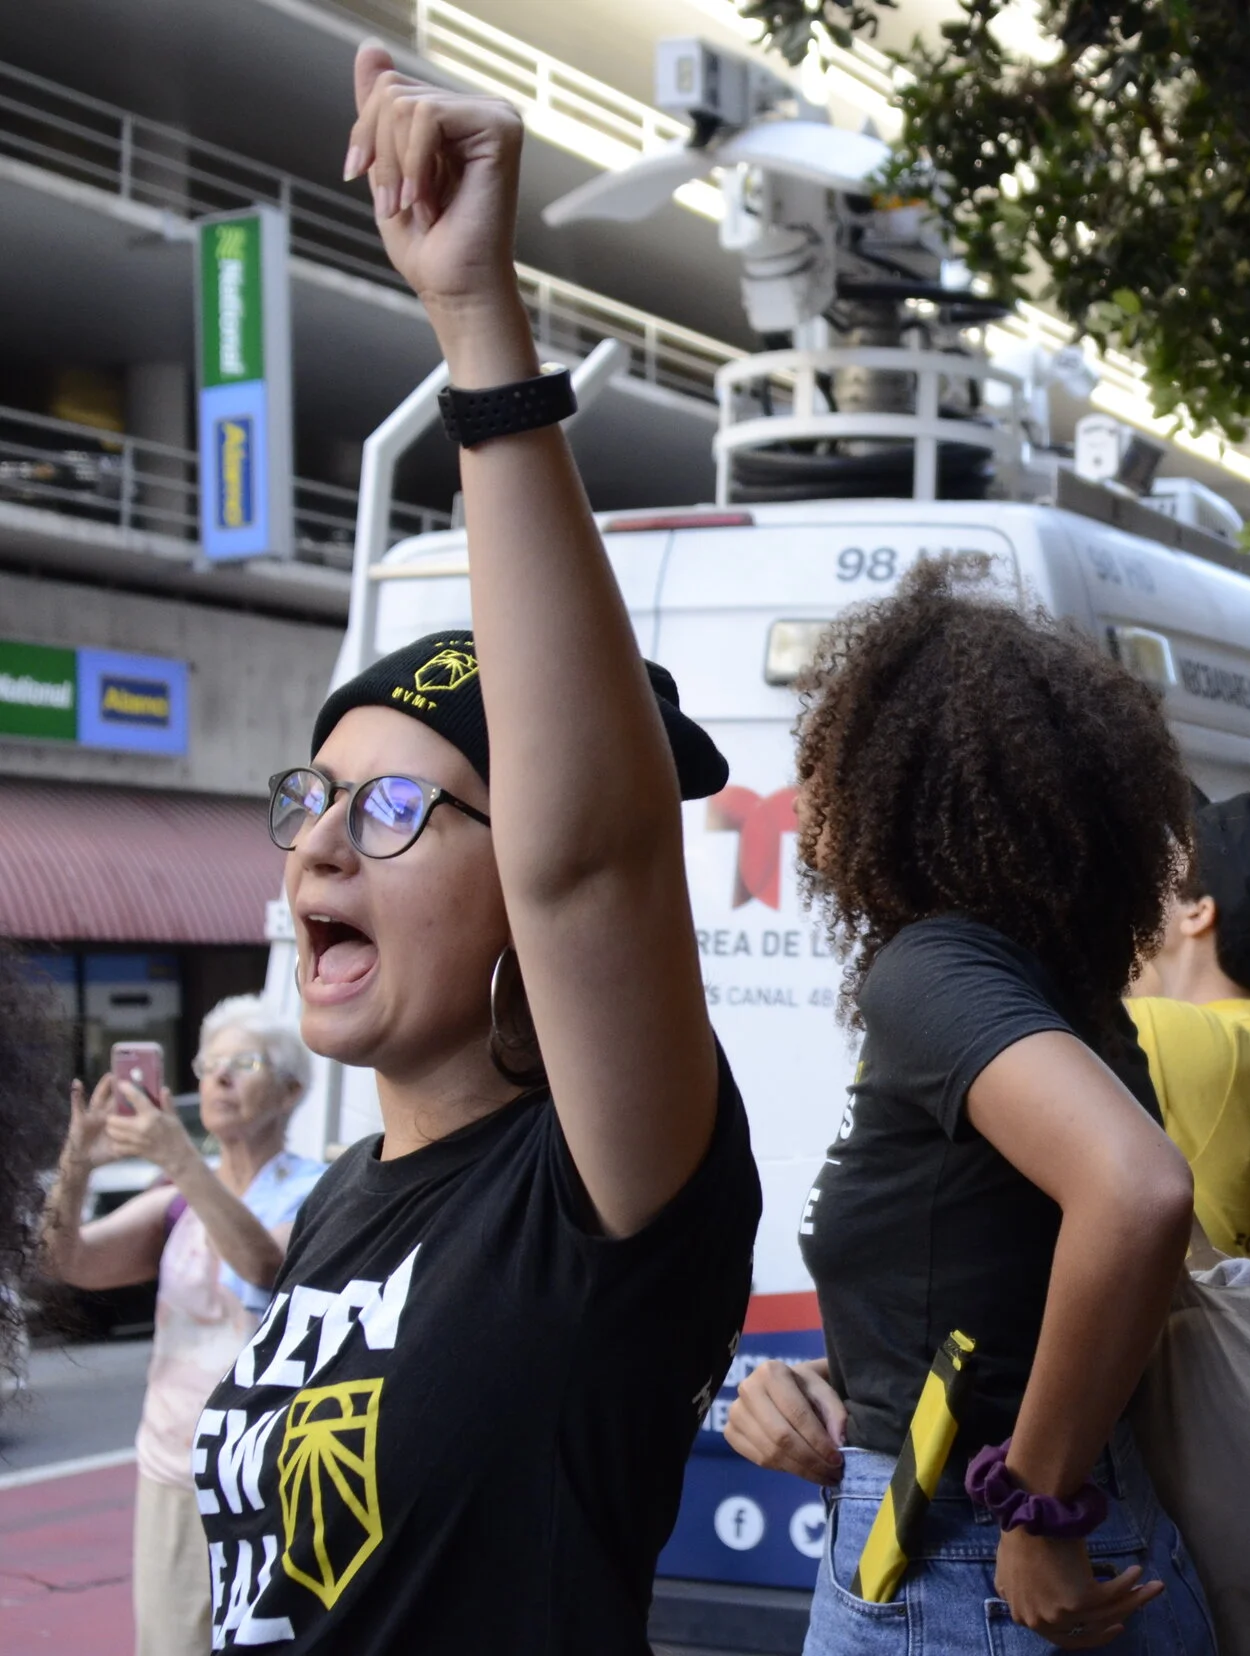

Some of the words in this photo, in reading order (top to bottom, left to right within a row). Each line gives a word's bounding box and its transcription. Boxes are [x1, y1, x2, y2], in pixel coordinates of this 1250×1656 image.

[217, 258, 245, 376] National
[224, 421, 246, 528] Alamo
[836, 547, 898, 582] 98
[103, 686, 168, 718] Alamo
[391, 686, 438, 711] MVMT
[763, 930, 801, 957] DE
[726, 986, 798, 1008] CANAL
